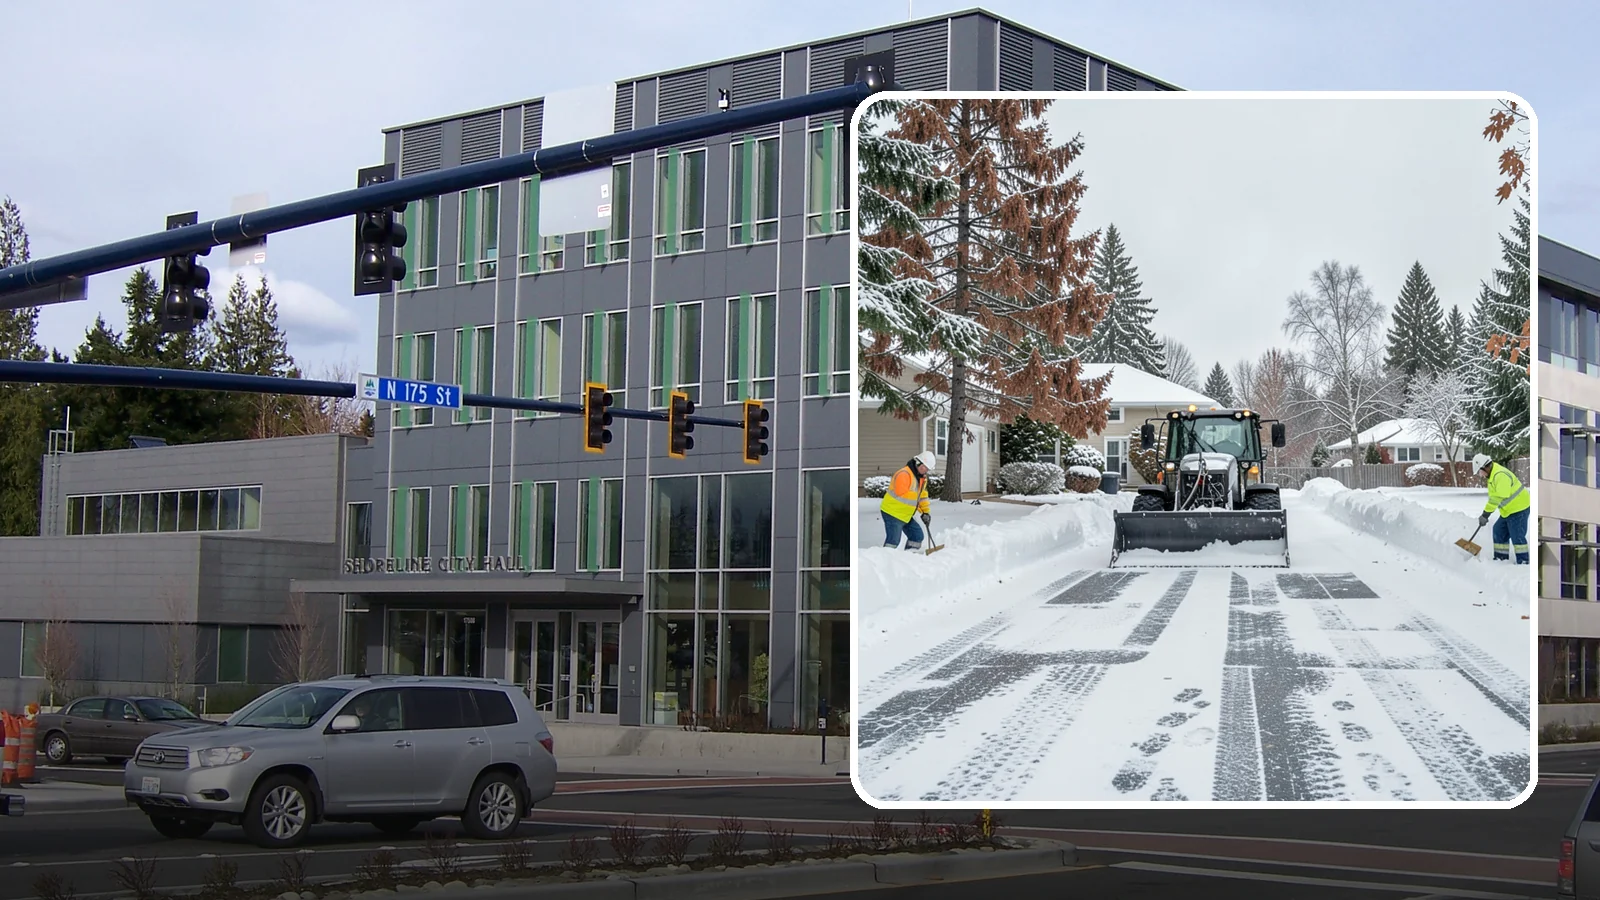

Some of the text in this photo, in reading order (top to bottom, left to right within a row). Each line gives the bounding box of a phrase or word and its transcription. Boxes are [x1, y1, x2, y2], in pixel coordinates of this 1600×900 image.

[387, 380, 451, 406] N 175 St
[344, 555, 527, 574] SHORELINE CITY HALL
